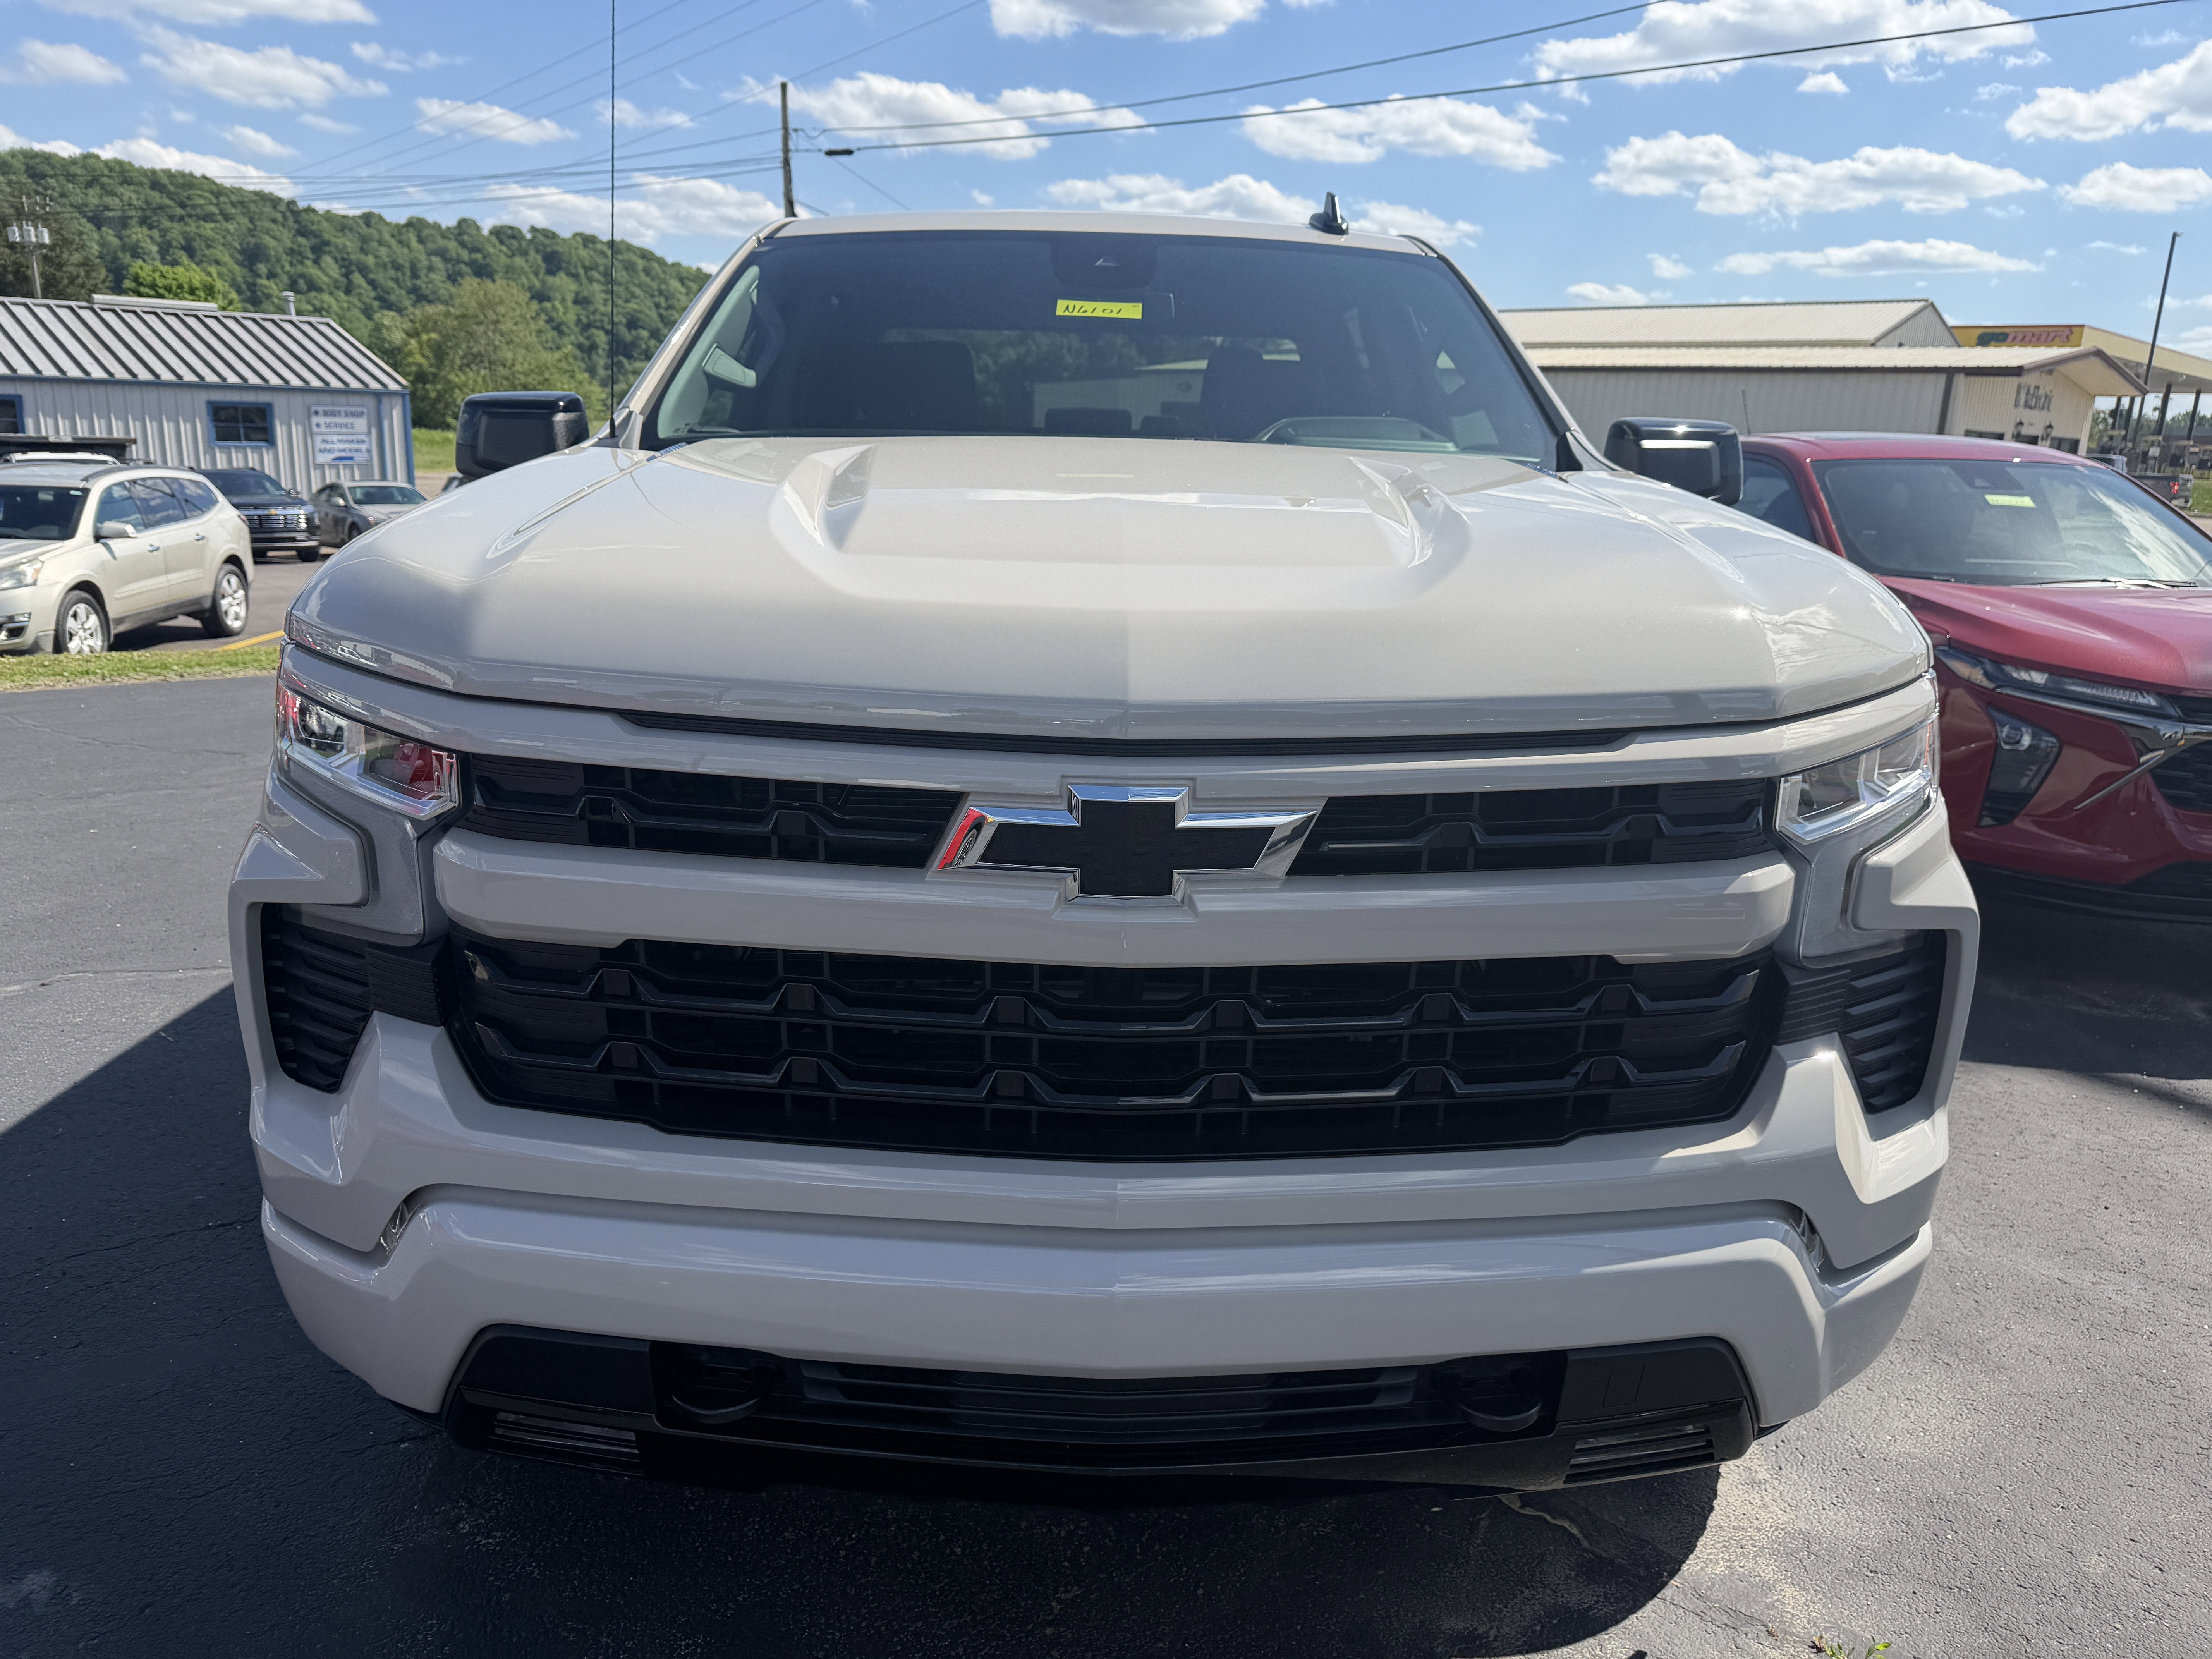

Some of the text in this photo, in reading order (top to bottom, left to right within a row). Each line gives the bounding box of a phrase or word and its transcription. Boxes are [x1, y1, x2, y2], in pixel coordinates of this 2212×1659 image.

[1063, 304, 1122, 314] N6101
[343, 410, 364, 418] SHOP
[323, 421, 355, 430] SERVICE
